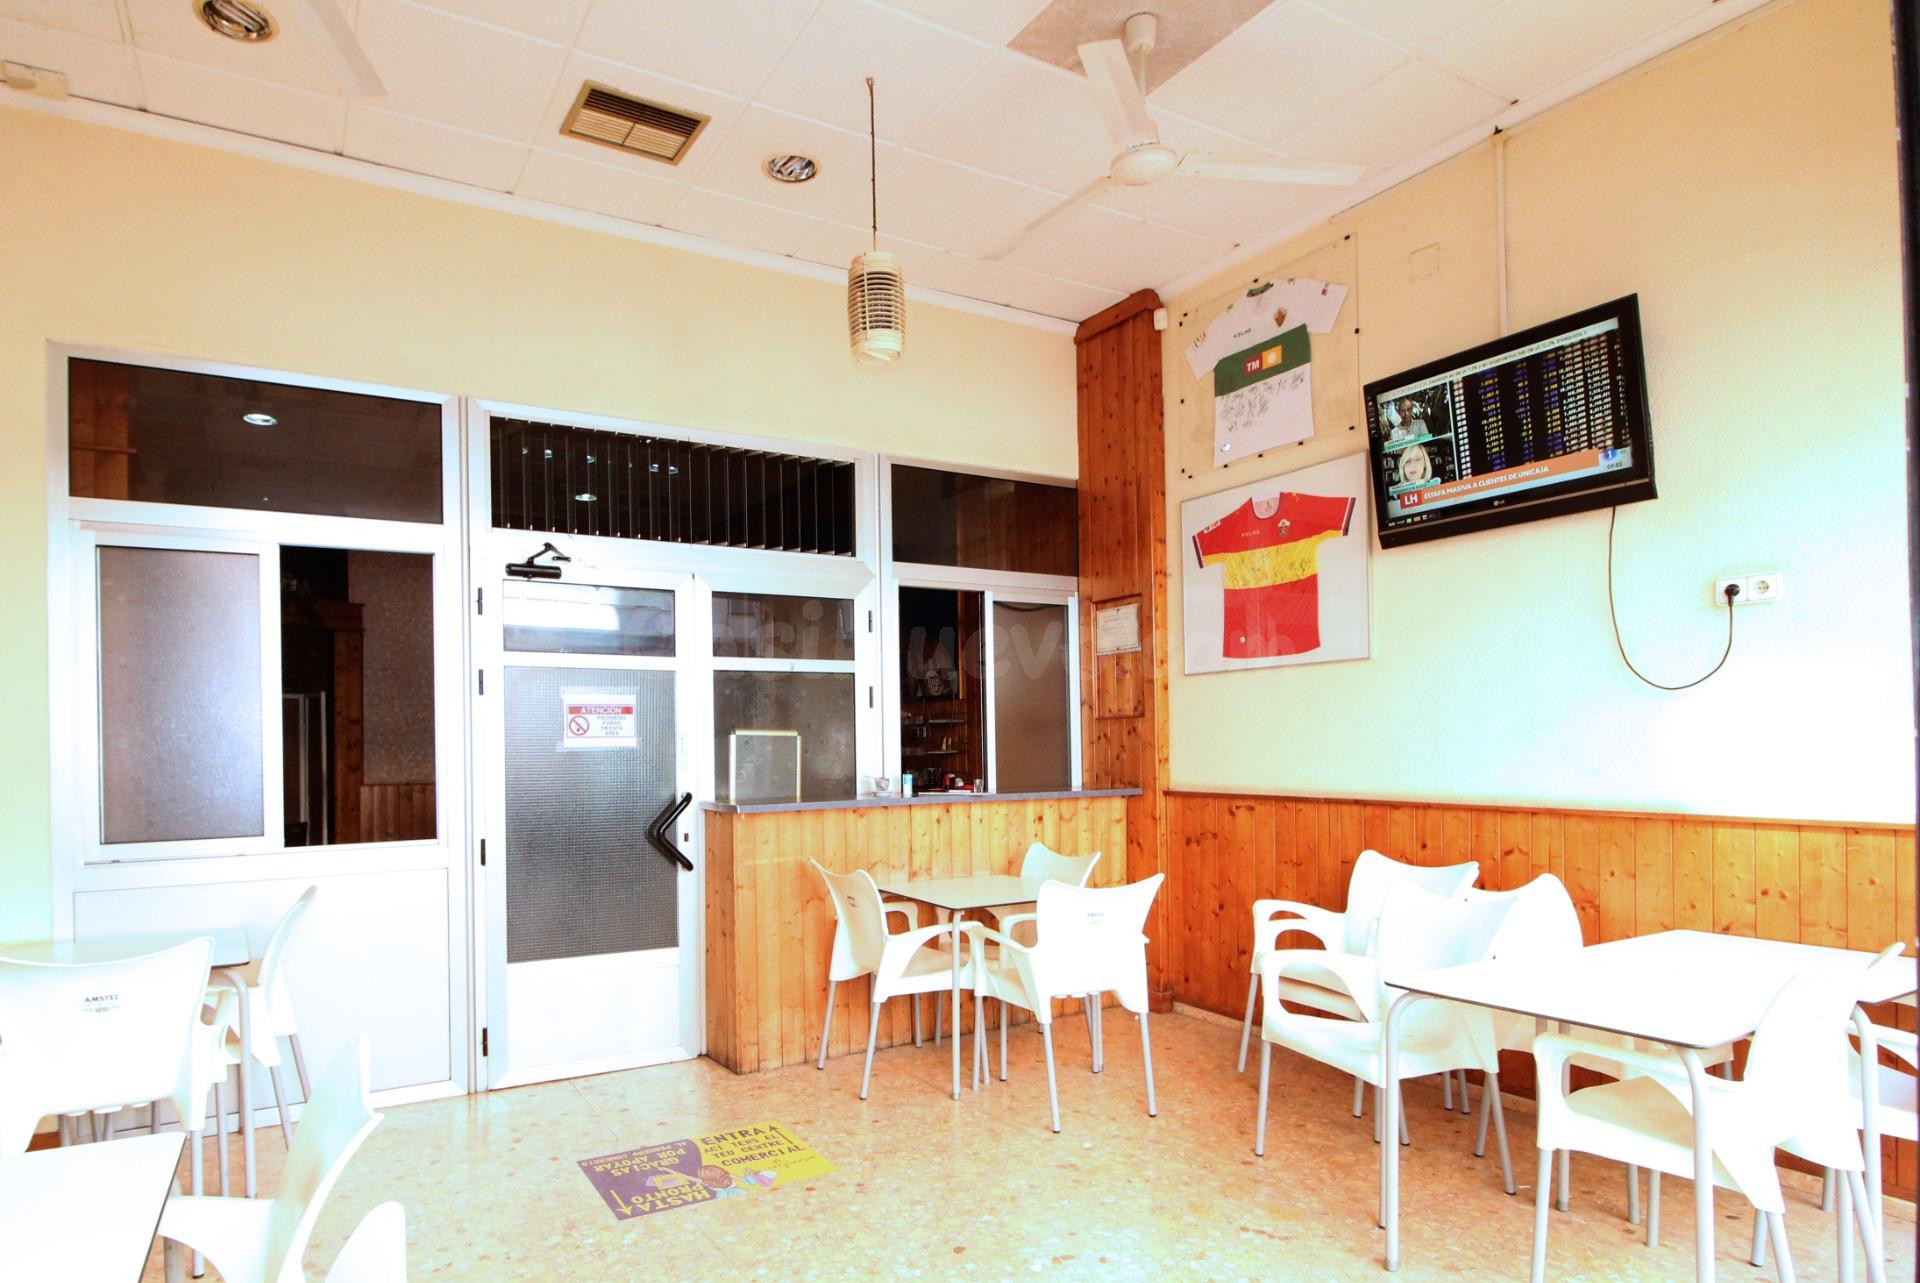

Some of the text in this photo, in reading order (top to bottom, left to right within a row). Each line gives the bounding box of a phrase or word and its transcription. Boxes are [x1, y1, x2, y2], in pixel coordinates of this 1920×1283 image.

[1246, 359, 1260, 373] TM
[1424, 488, 1447, 499] ESTAFA
[1447, 483, 1472, 494] MASIVA
[1479, 475, 1508, 487] CLIENTES
[1518, 465, 1549, 479] UNICAJA
[1404, 493, 1418, 506] LH
[701, 1127, 766, 1146] ENTRA
[767, 1132, 781, 1142] EL
[714, 1139, 785, 1159] TEU CENTRE
[721, 1145, 807, 1167] COMERCIAL
[593, 1148, 686, 1173] POR APOYAR
[612, 1157, 679, 1178] GRACIAS
[630, 1183, 702, 1205] PRONTO
[635, 1188, 712, 1214] HASTA
